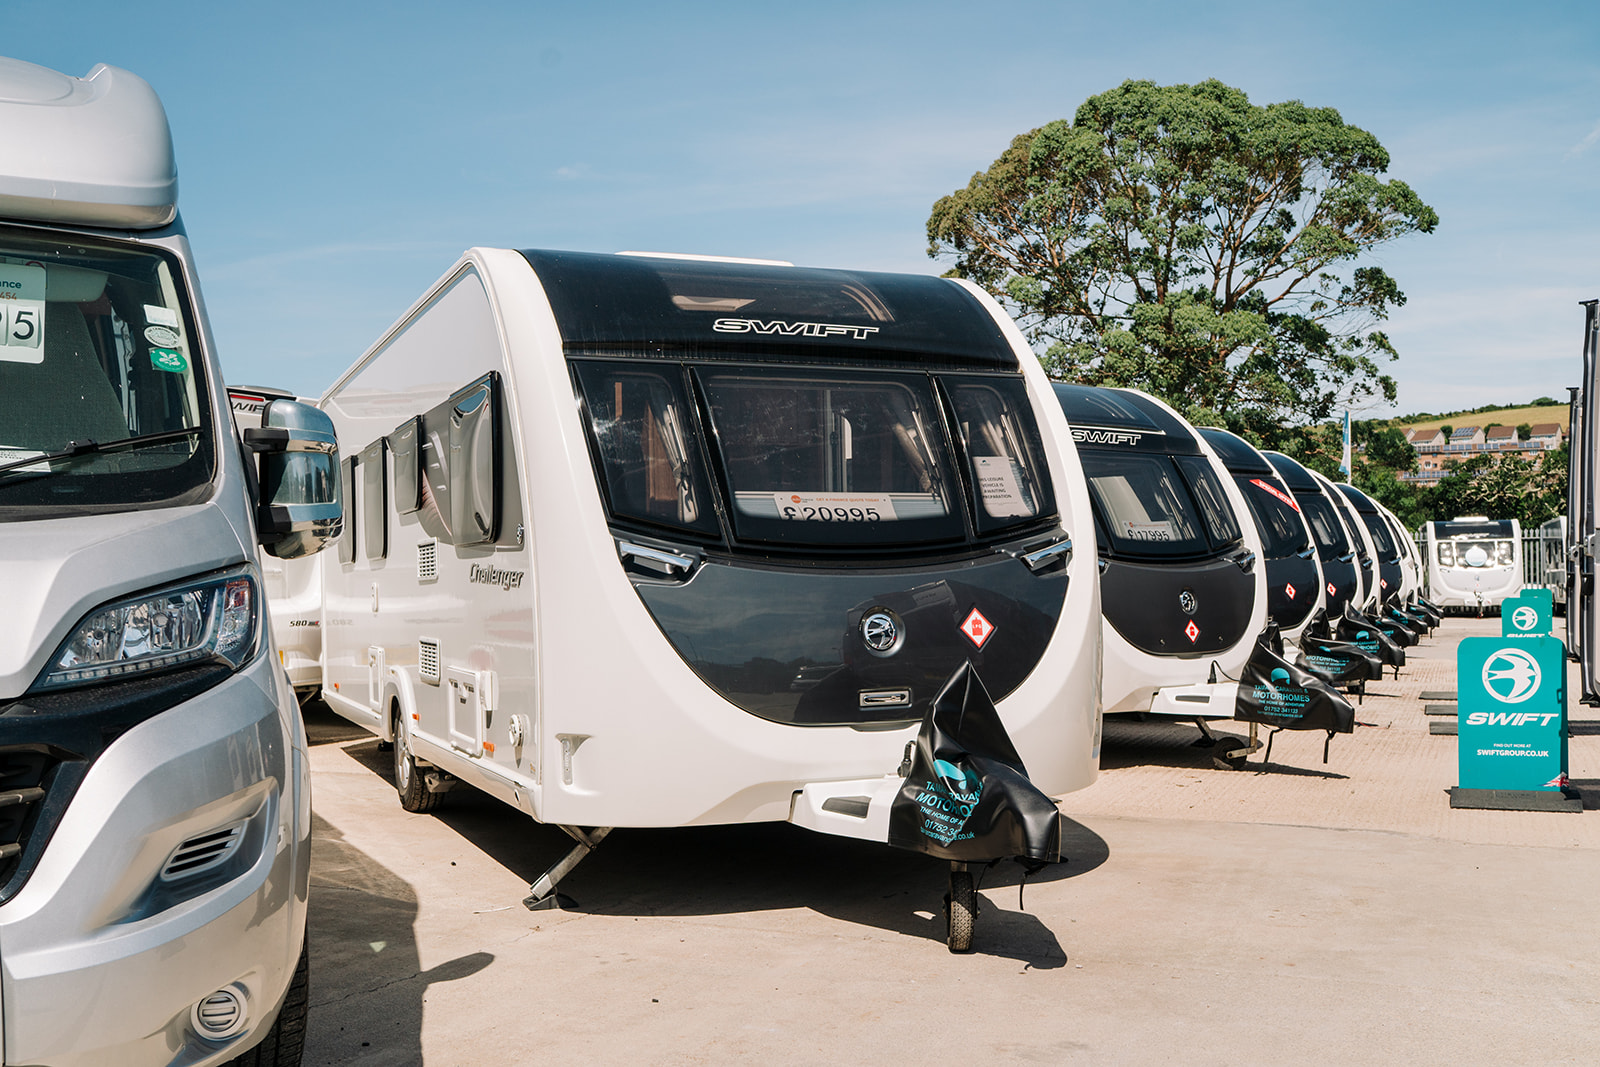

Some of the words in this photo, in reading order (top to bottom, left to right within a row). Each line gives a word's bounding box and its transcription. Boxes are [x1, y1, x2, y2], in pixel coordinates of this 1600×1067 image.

[713, 318, 880, 340] SWIFT
[1070, 429, 1142, 446] SWIFT
[469, 562, 524, 591] Challenger
[1252, 691, 1311, 703] MOTORHOMES
[1466, 712, 1559, 726] SWIFT
[1477, 749, 1549, 757] SWIFTGROUP.CO.UK
[931, 811, 949, 823] HOME
[924, 819, 948, 834] 01752
